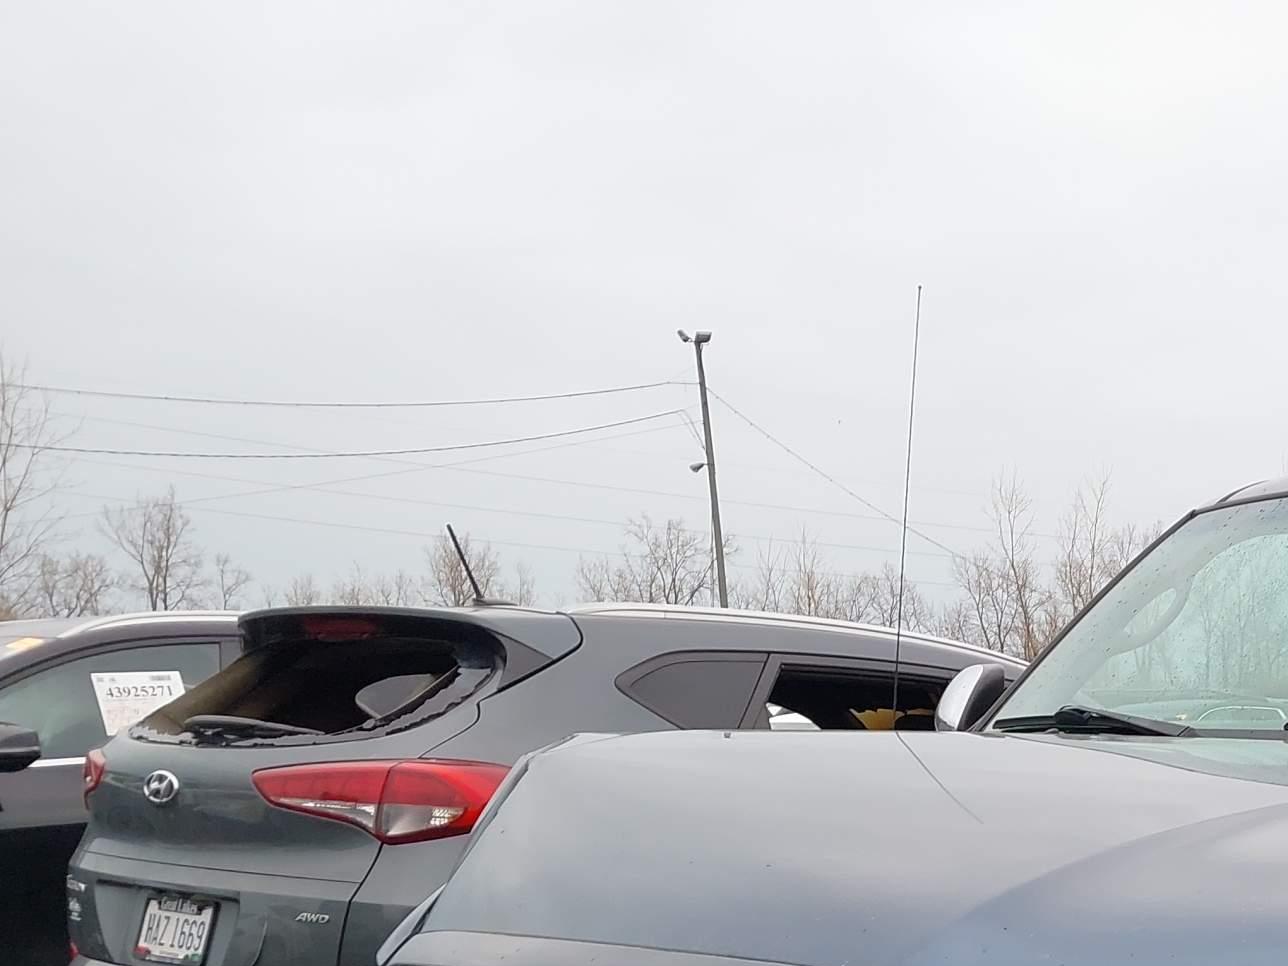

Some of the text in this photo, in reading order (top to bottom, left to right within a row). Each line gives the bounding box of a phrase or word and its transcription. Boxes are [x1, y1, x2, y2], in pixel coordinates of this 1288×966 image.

[105, 684, 173, 699] 43925271
[295, 911, 330, 924] AWD
[168, 916, 207, 952] 1669
